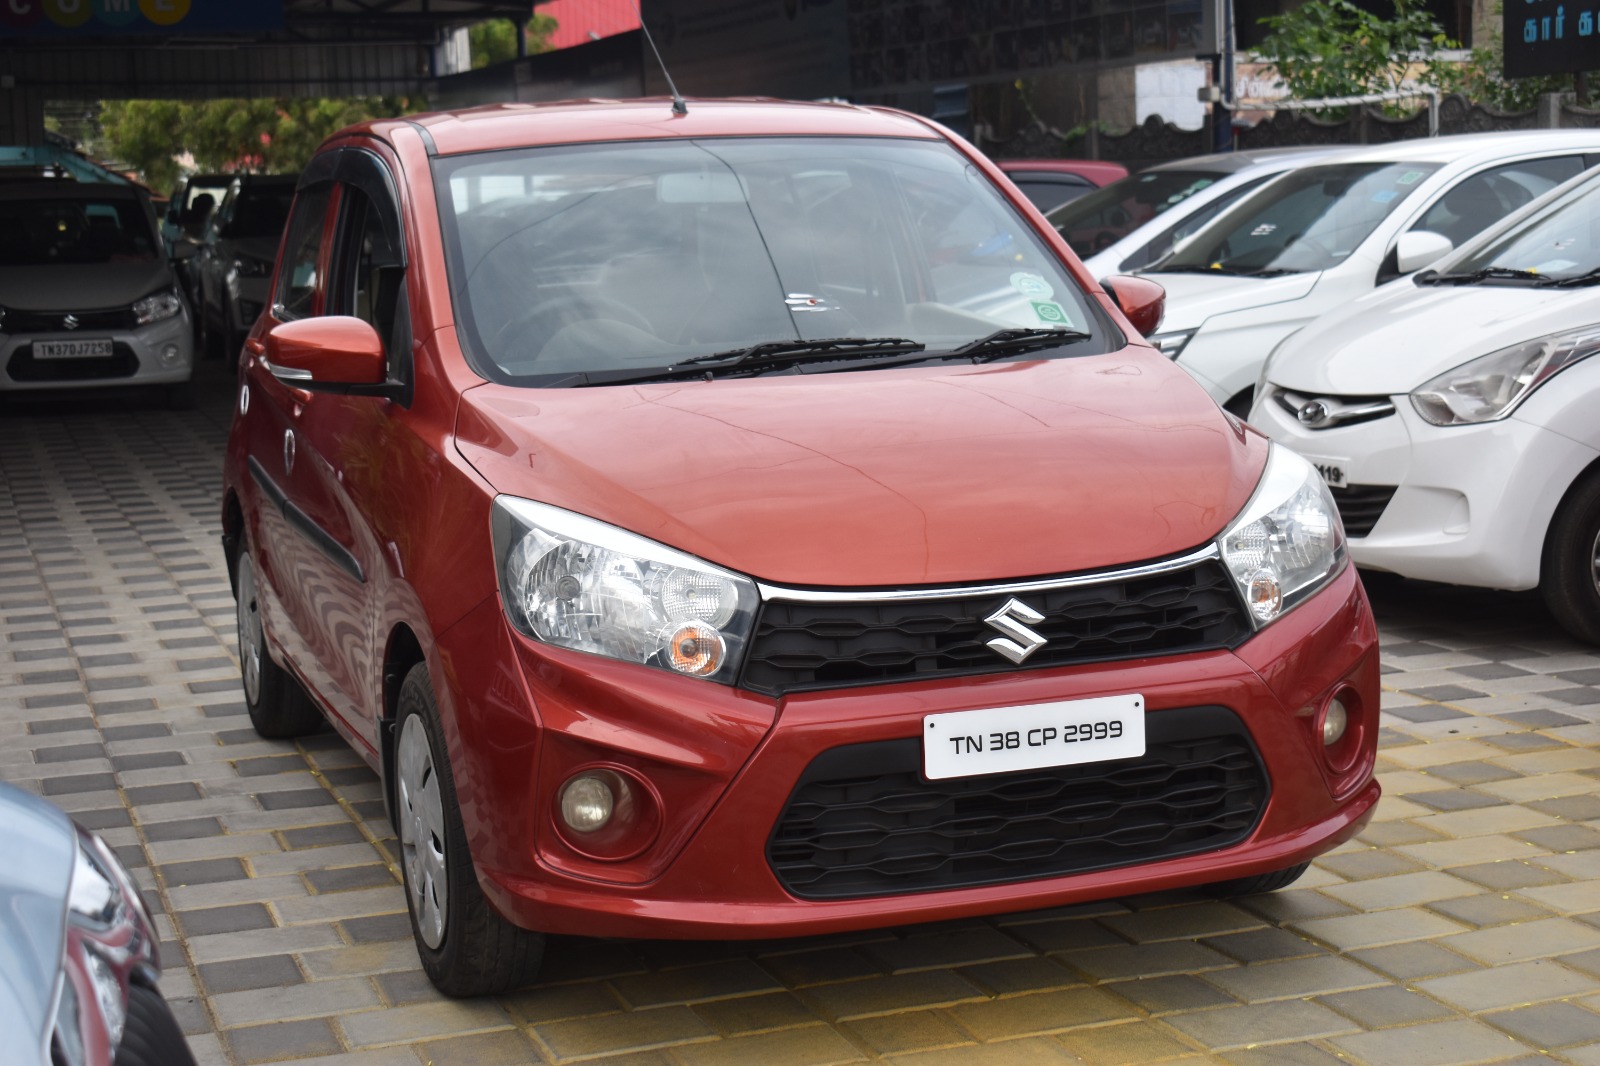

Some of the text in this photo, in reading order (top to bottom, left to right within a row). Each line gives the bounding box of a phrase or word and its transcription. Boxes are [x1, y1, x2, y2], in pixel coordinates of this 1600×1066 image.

[1313, 464, 1342, 482] 119
[949, 720, 1123, 755] TN 38 CP 2999
